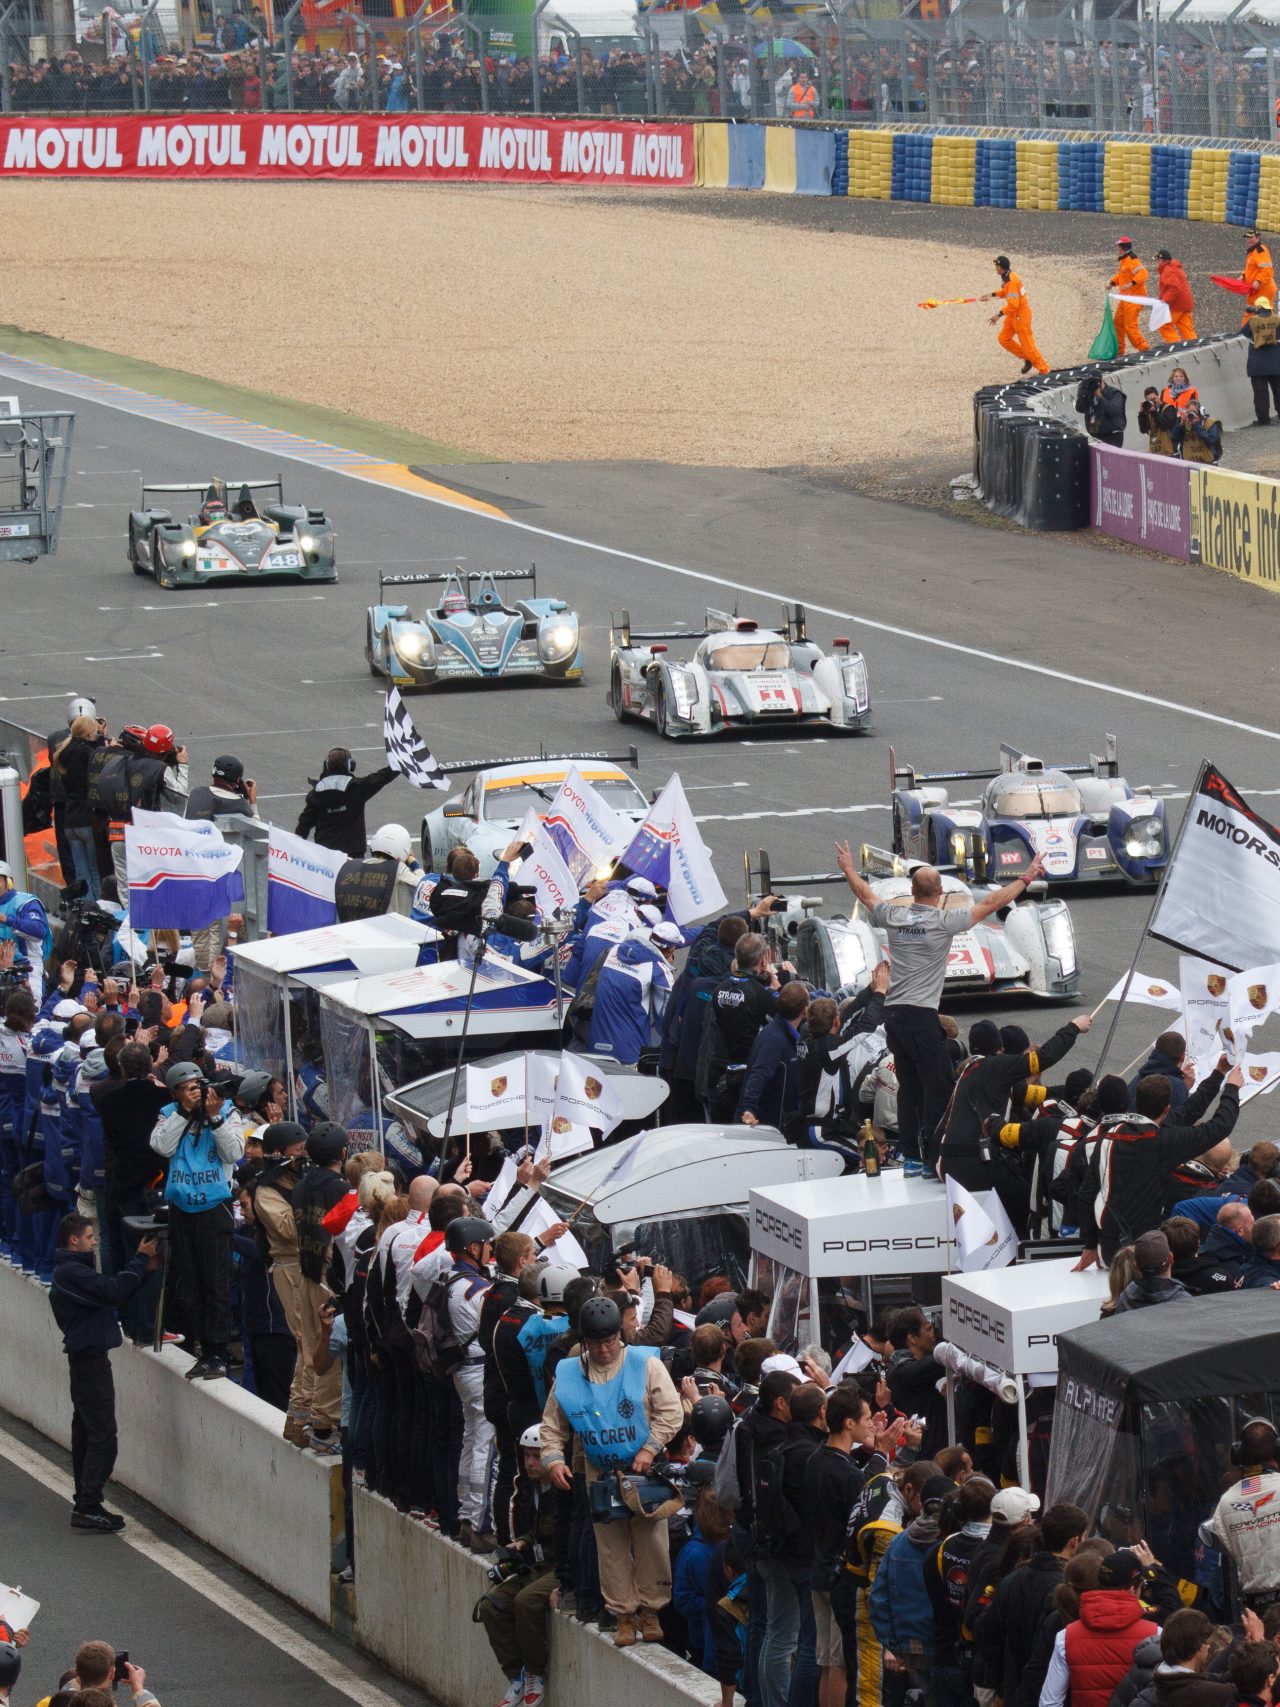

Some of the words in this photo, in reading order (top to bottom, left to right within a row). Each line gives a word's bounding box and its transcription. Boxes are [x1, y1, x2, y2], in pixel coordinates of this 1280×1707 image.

[4, 127, 122, 169] MOTUL
[137, 125, 246, 166] MOTUL
[259, 124, 362, 167] MOTUL
[375, 125, 468, 167] MOTUL
[479, 127, 551, 171] MOTUL
[561, 131, 624, 175] MOTUL
[631, 134, 684, 178] MOTUL
[1203, 471, 1252, 577] france
[271, 553, 298, 567] 48
[137, 845, 182, 857] TOYOTA
[184, 847, 232, 859] HYBRID
[1002, 853, 1020, 864] HY
[1089, 848, 1106, 859] P1
[290, 856, 335, 880] HYBRID
[534, 863, 565, 907] TOYOTA
[897, 927, 927, 936] STRAKKA
[949, 950, 970, 964] 2
[560, 1095, 613, 1121] PORSCHE
[171, 1169, 191, 1184] ENG
[186, 1192, 207, 1206] 113
[755, 1208, 802, 1250] PORSCHE
[823, 1236, 958, 1254] PORSCH
[950, 1297, 1005, 1345] PORSCHE
[525, 1335, 545, 1351] 24
[600, 1426, 637, 1446] CREW
